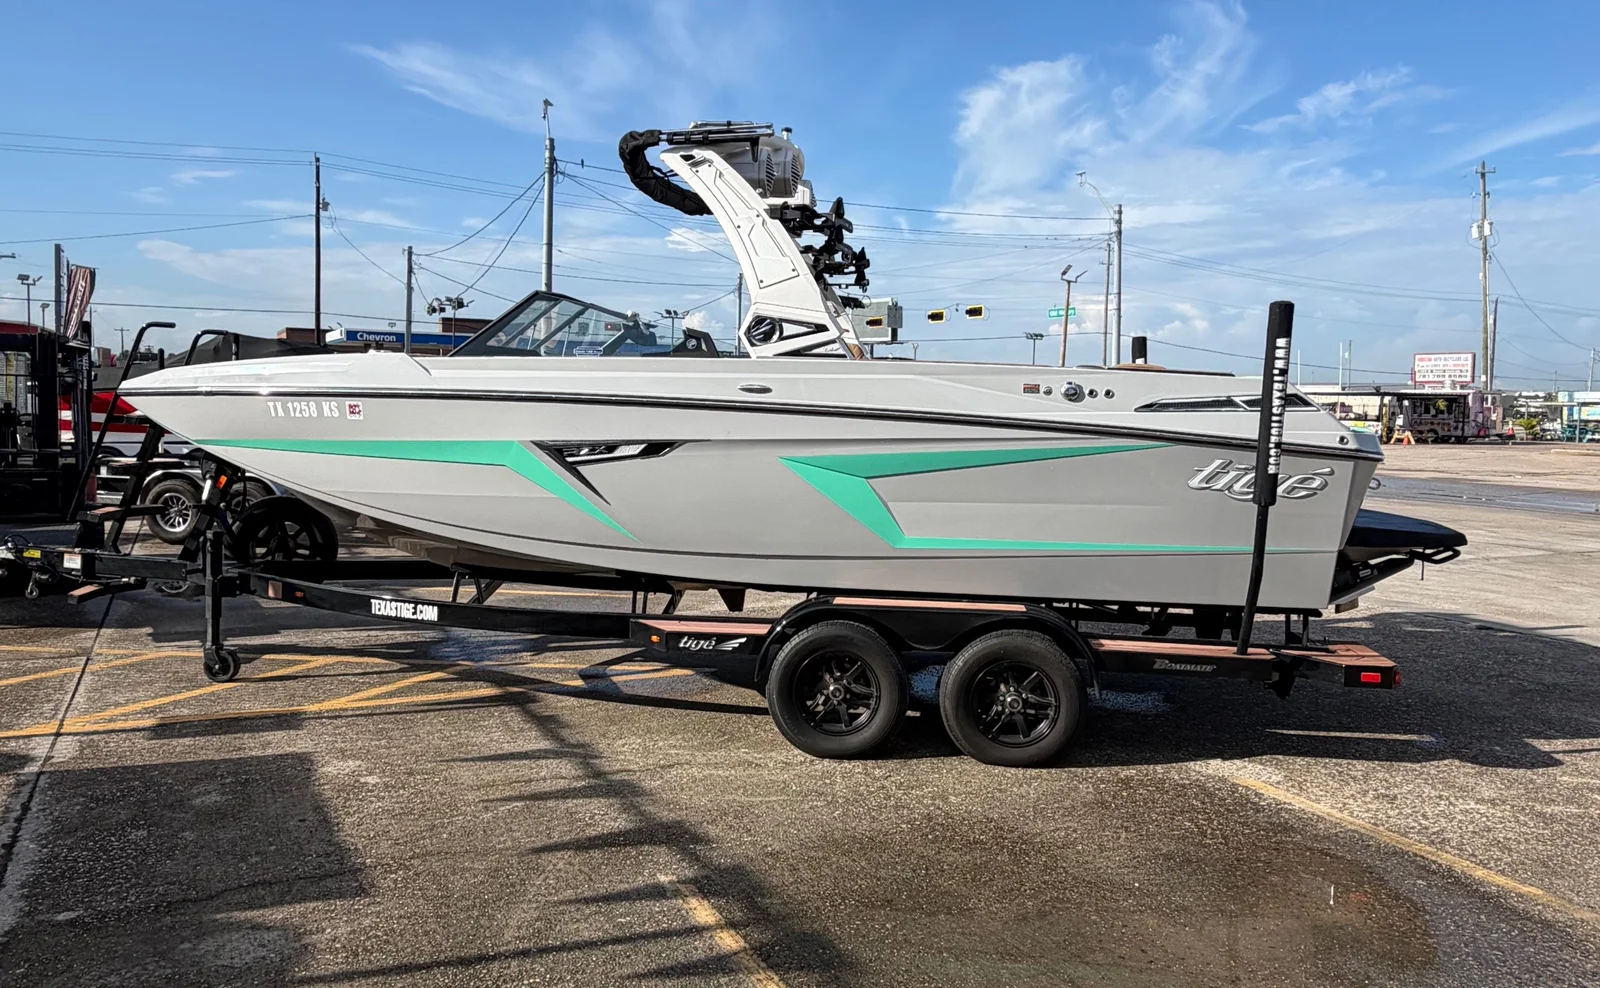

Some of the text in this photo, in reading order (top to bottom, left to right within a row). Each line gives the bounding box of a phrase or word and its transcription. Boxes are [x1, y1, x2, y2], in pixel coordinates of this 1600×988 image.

[357, 332, 396, 342] Chevron
[267, 402, 285, 417] TX
[287, 402, 317, 417] 1258
[322, 402, 340, 417] KS
[370, 599, 438, 621] TEXASTIGE.COM
